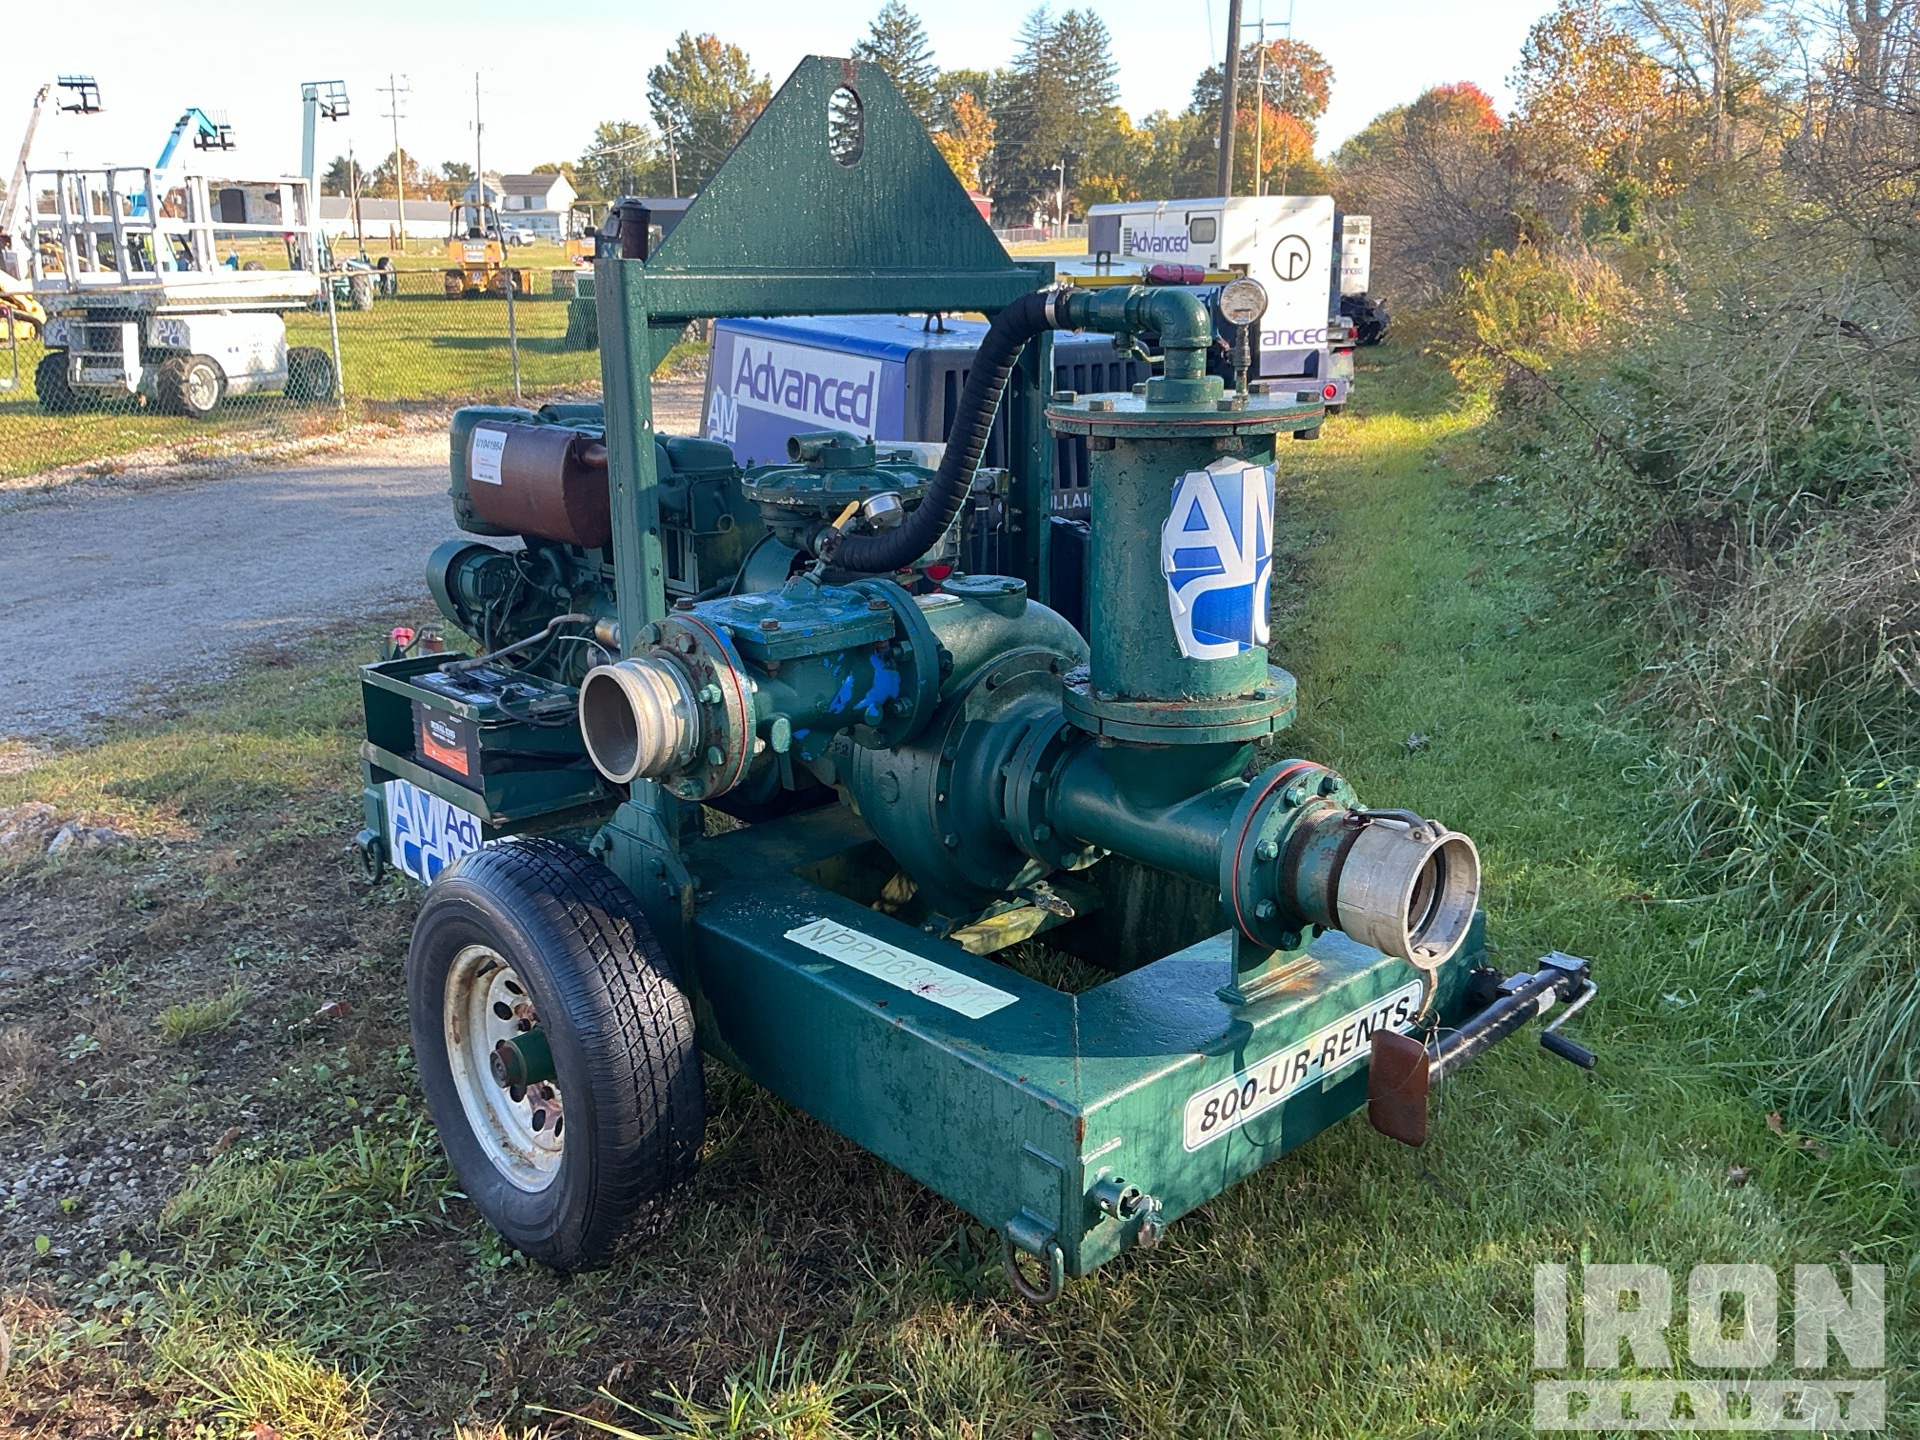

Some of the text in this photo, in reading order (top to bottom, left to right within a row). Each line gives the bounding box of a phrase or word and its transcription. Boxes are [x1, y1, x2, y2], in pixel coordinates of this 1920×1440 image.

[1130, 230, 1188, 253] Advanced
[1260, 325, 1328, 346] anced
[734, 347, 876, 429] Advanced
[1050, 493, 1091, 511] LLAI
[1199, 995, 1410, 1133] 800-UR-RENTS
